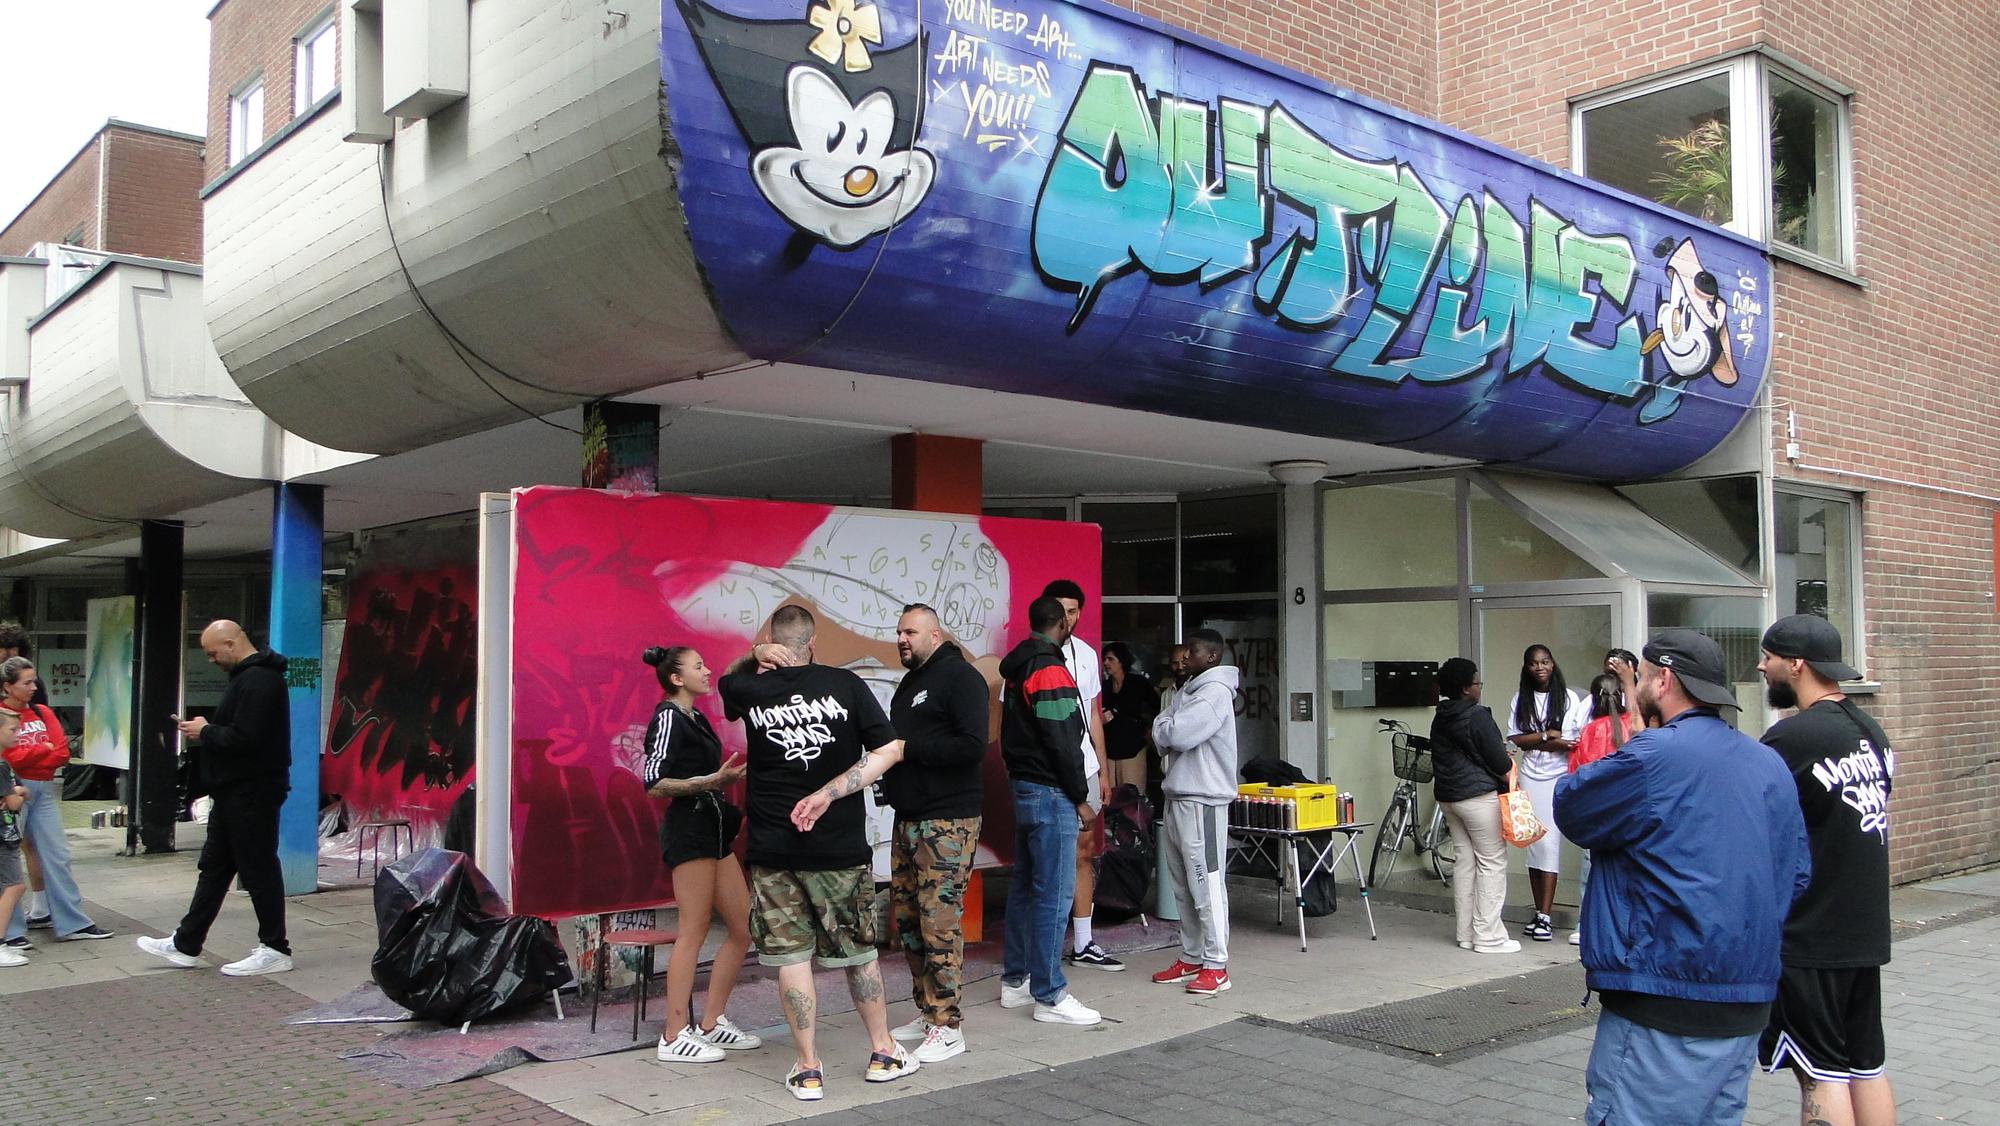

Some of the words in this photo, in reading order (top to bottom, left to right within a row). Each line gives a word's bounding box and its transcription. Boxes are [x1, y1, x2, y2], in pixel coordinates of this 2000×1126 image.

[944, 0, 975, 25] YOU
[979, 0, 1028, 35] NEED
[934, 29, 988, 75] ART
[982, 50, 1052, 98] NEEDS
[960, 80, 1036, 140] YOU!!
[1294, 586, 1306, 605] 8
[749, 694, 849, 730] MONTANA
[1194, 864, 1206, 885] NIKE
